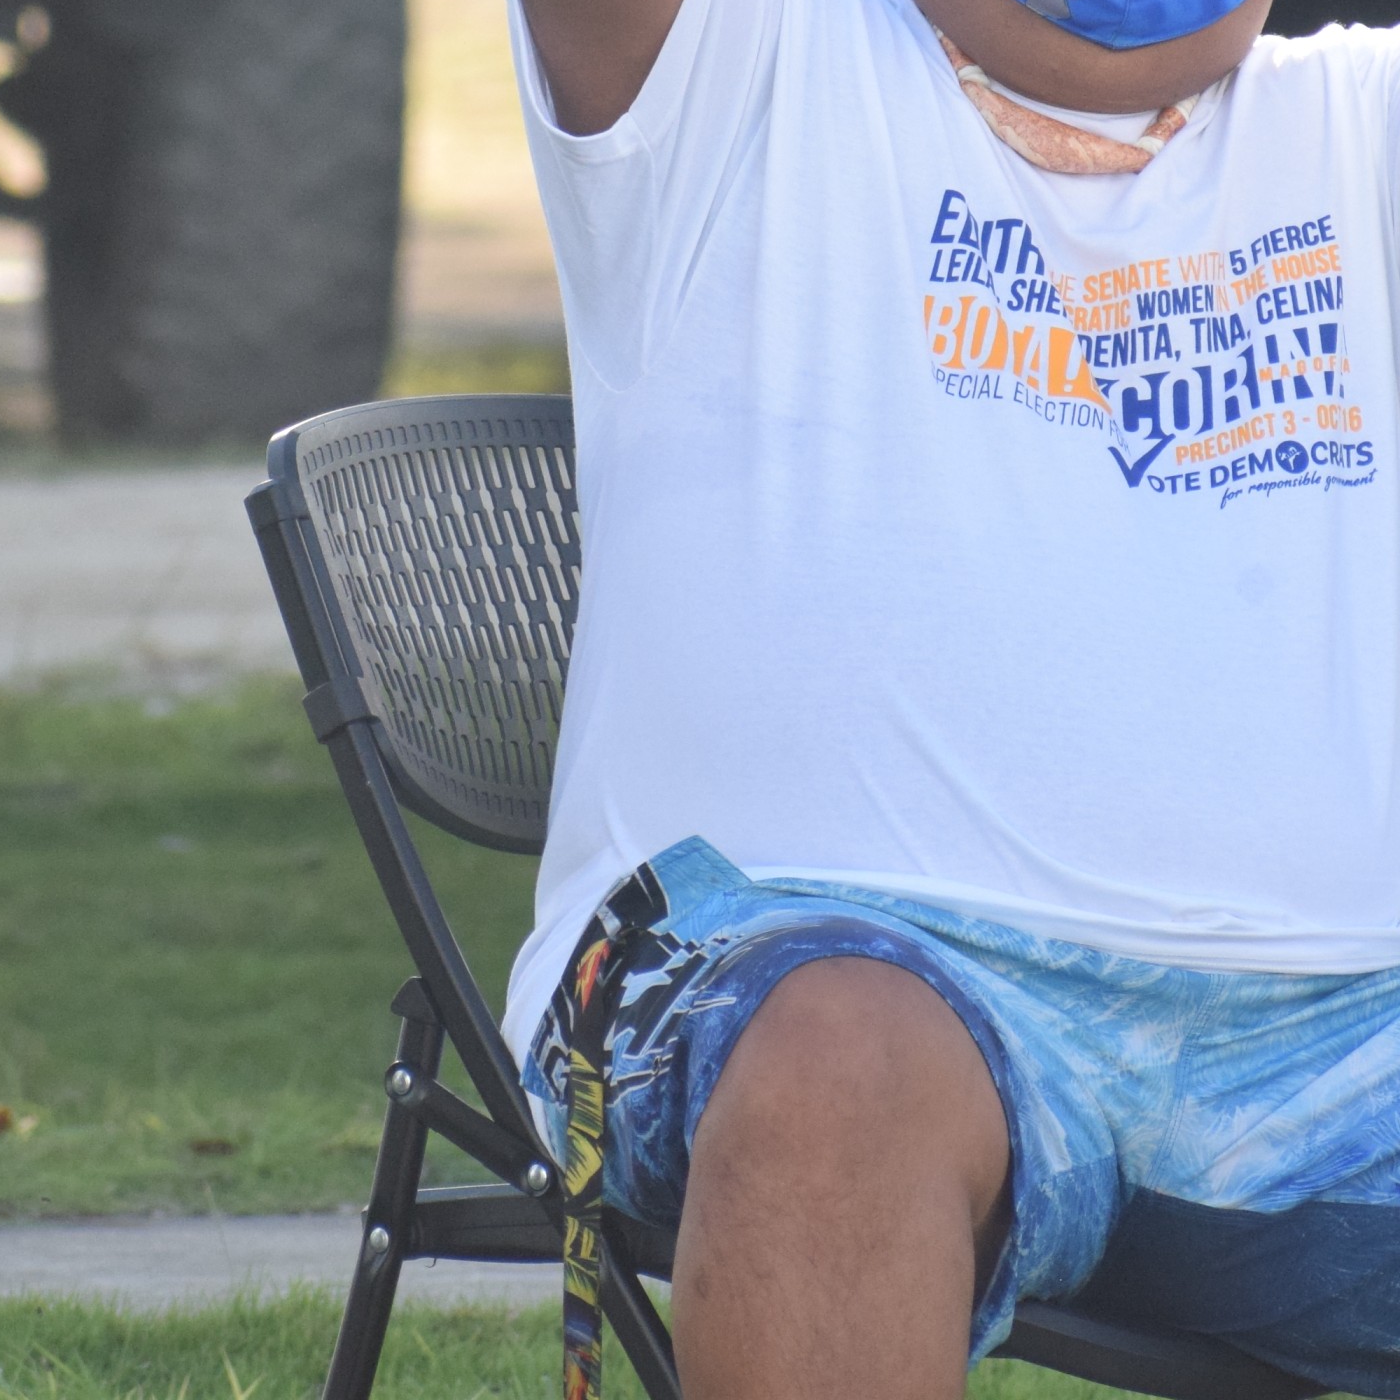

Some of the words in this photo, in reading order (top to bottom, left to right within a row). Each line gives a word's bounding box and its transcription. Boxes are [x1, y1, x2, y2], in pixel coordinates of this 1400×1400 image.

[1081, 258, 1172, 304] SENATE
[1178, 251, 1226, 284] WITH
[1229, 248, 1248, 276] 5
[1250, 214, 1337, 267] FIERCE
[1136, 284, 1214, 321] WOMEN
[1230, 263, 1269, 306] THE
[1271, 244, 1343, 284] HOUSE
[1013, 380, 1104, 431] ELECTION
[1175, 411, 1276, 466] PRECINCT
[1282, 409, 1297, 436] 3
[1219, 486, 1243, 510] for
[1247, 470, 1323, 498] responsible
